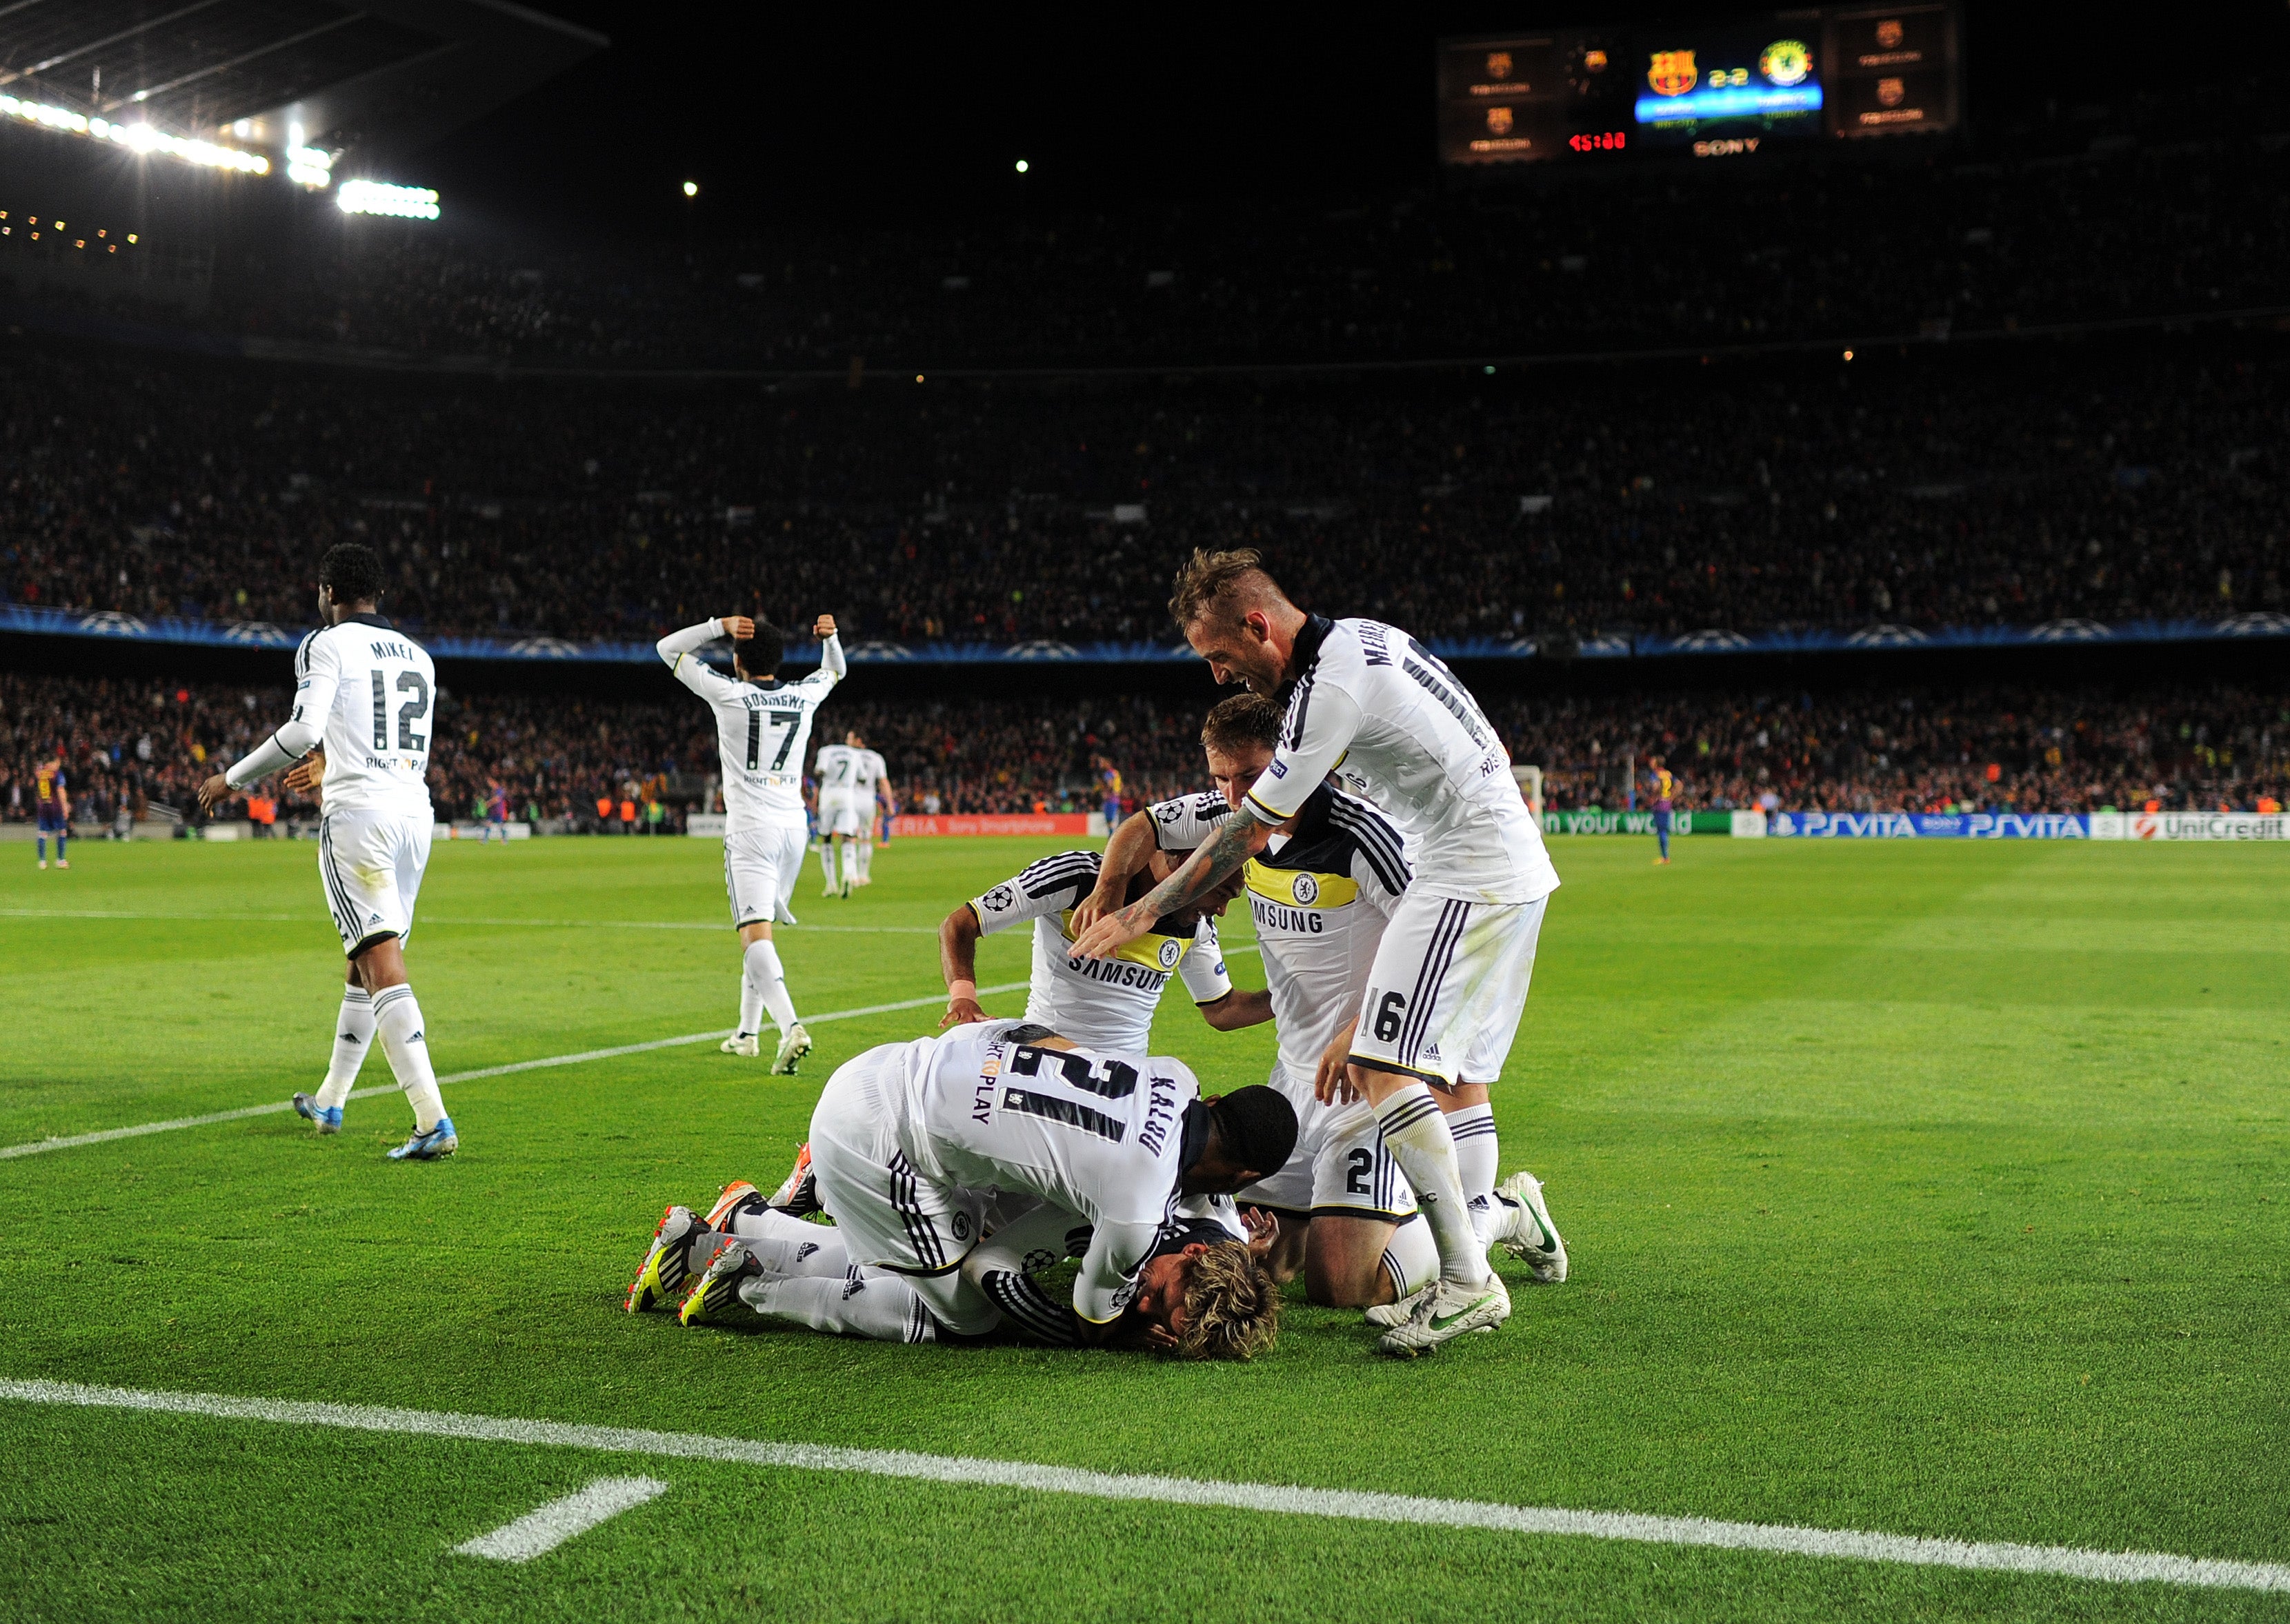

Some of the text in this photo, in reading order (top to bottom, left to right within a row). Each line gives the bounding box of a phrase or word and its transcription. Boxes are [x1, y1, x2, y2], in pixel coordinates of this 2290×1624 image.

[1693, 138, 1760, 157] SONY
[370, 641, 415, 663] MIKEL
[370, 669, 428, 753] 12
[746, 710, 802, 771] 17
[837, 760, 849, 781] 7
[1567, 812, 1621, 836] your
[1624, 810, 1692, 835] wold
[2166, 817, 2283, 839] UniCredit
[1248, 898, 1323, 934] MSUNG
[1069, 954, 1168, 992] SAMSUN
[1360, 987, 1407, 1044] 16
[971, 1074, 997, 1126] PLAY
[996, 1041, 1139, 1145] 21
[1139, 1076, 1176, 1159] KALOU
[1346, 1147, 1373, 1196] 2
